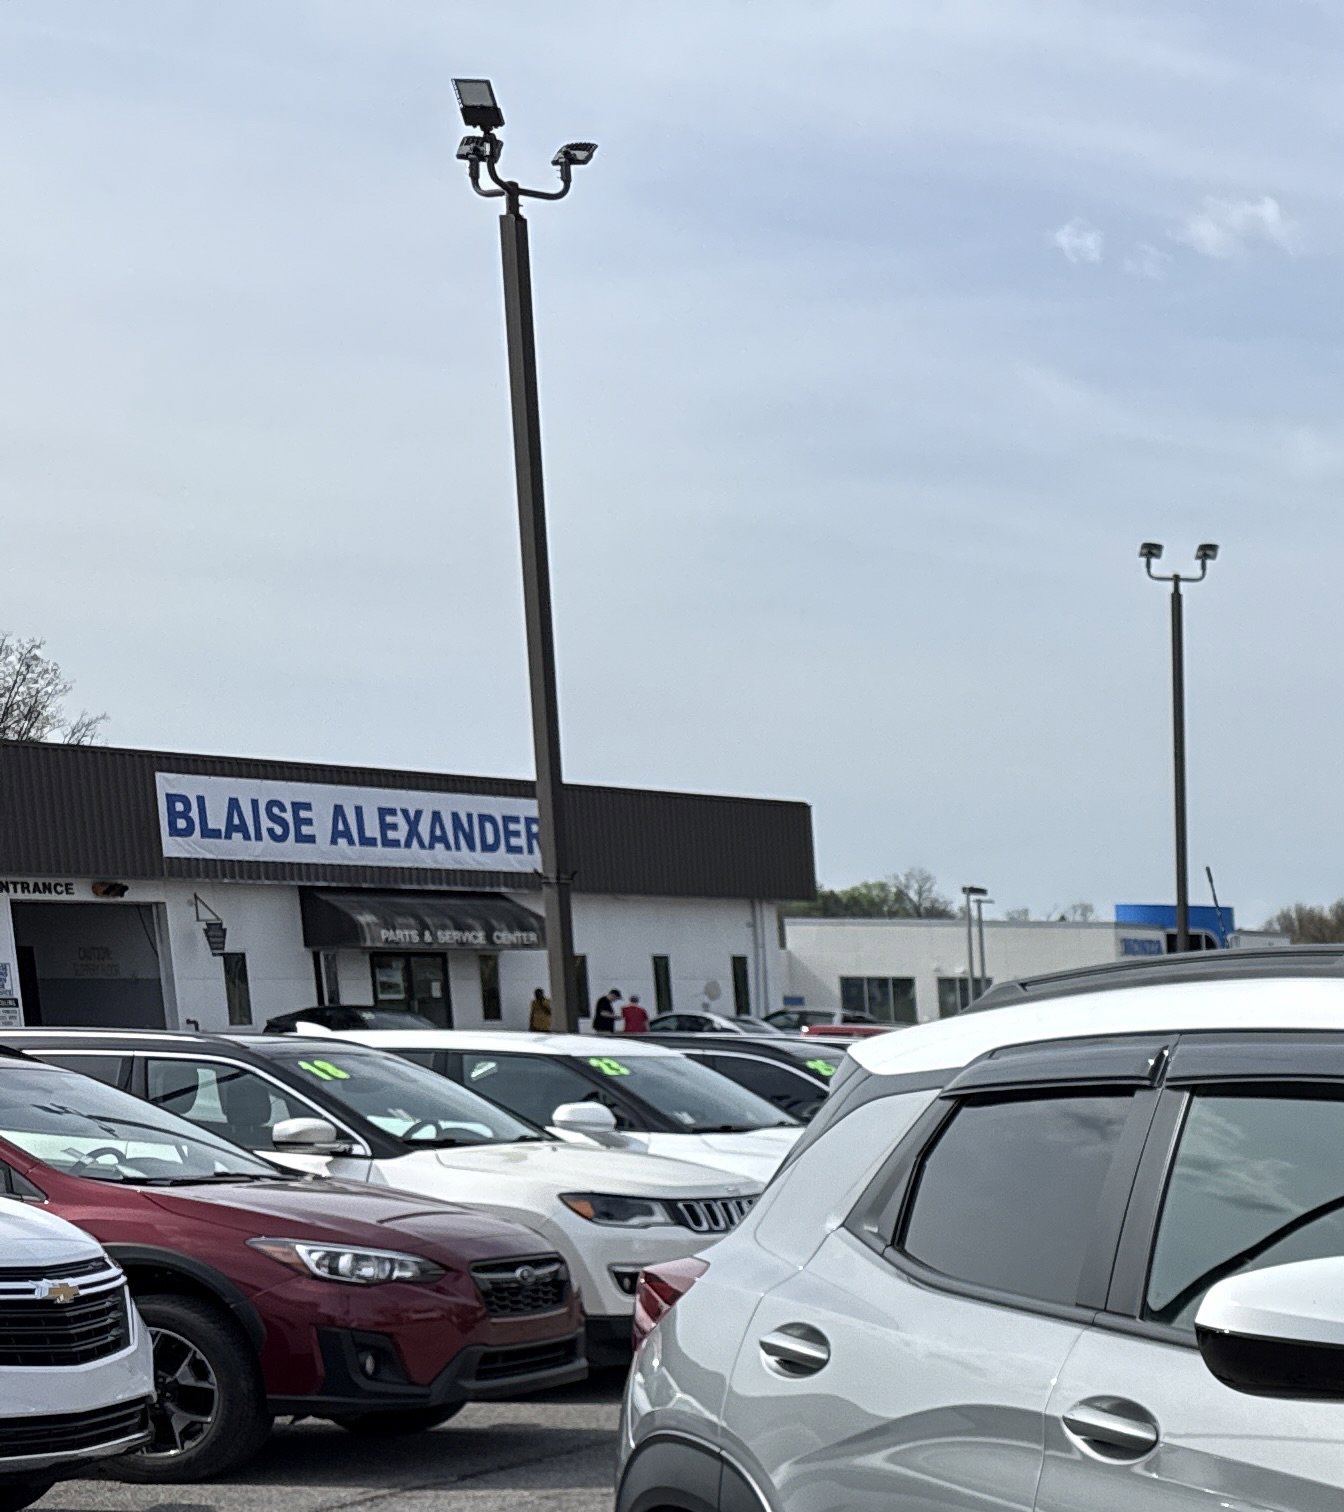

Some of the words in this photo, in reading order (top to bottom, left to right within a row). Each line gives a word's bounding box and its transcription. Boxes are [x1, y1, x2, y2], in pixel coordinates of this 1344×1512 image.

[165, 792, 317, 845] BLAISE
[330, 803, 541, 857] ALEXANDER
[380, 929, 419, 944] PARTS
[423, 930, 433, 944] &
[437, 930, 487, 945] SERVICE
[492, 931, 538, 946] CENTER
